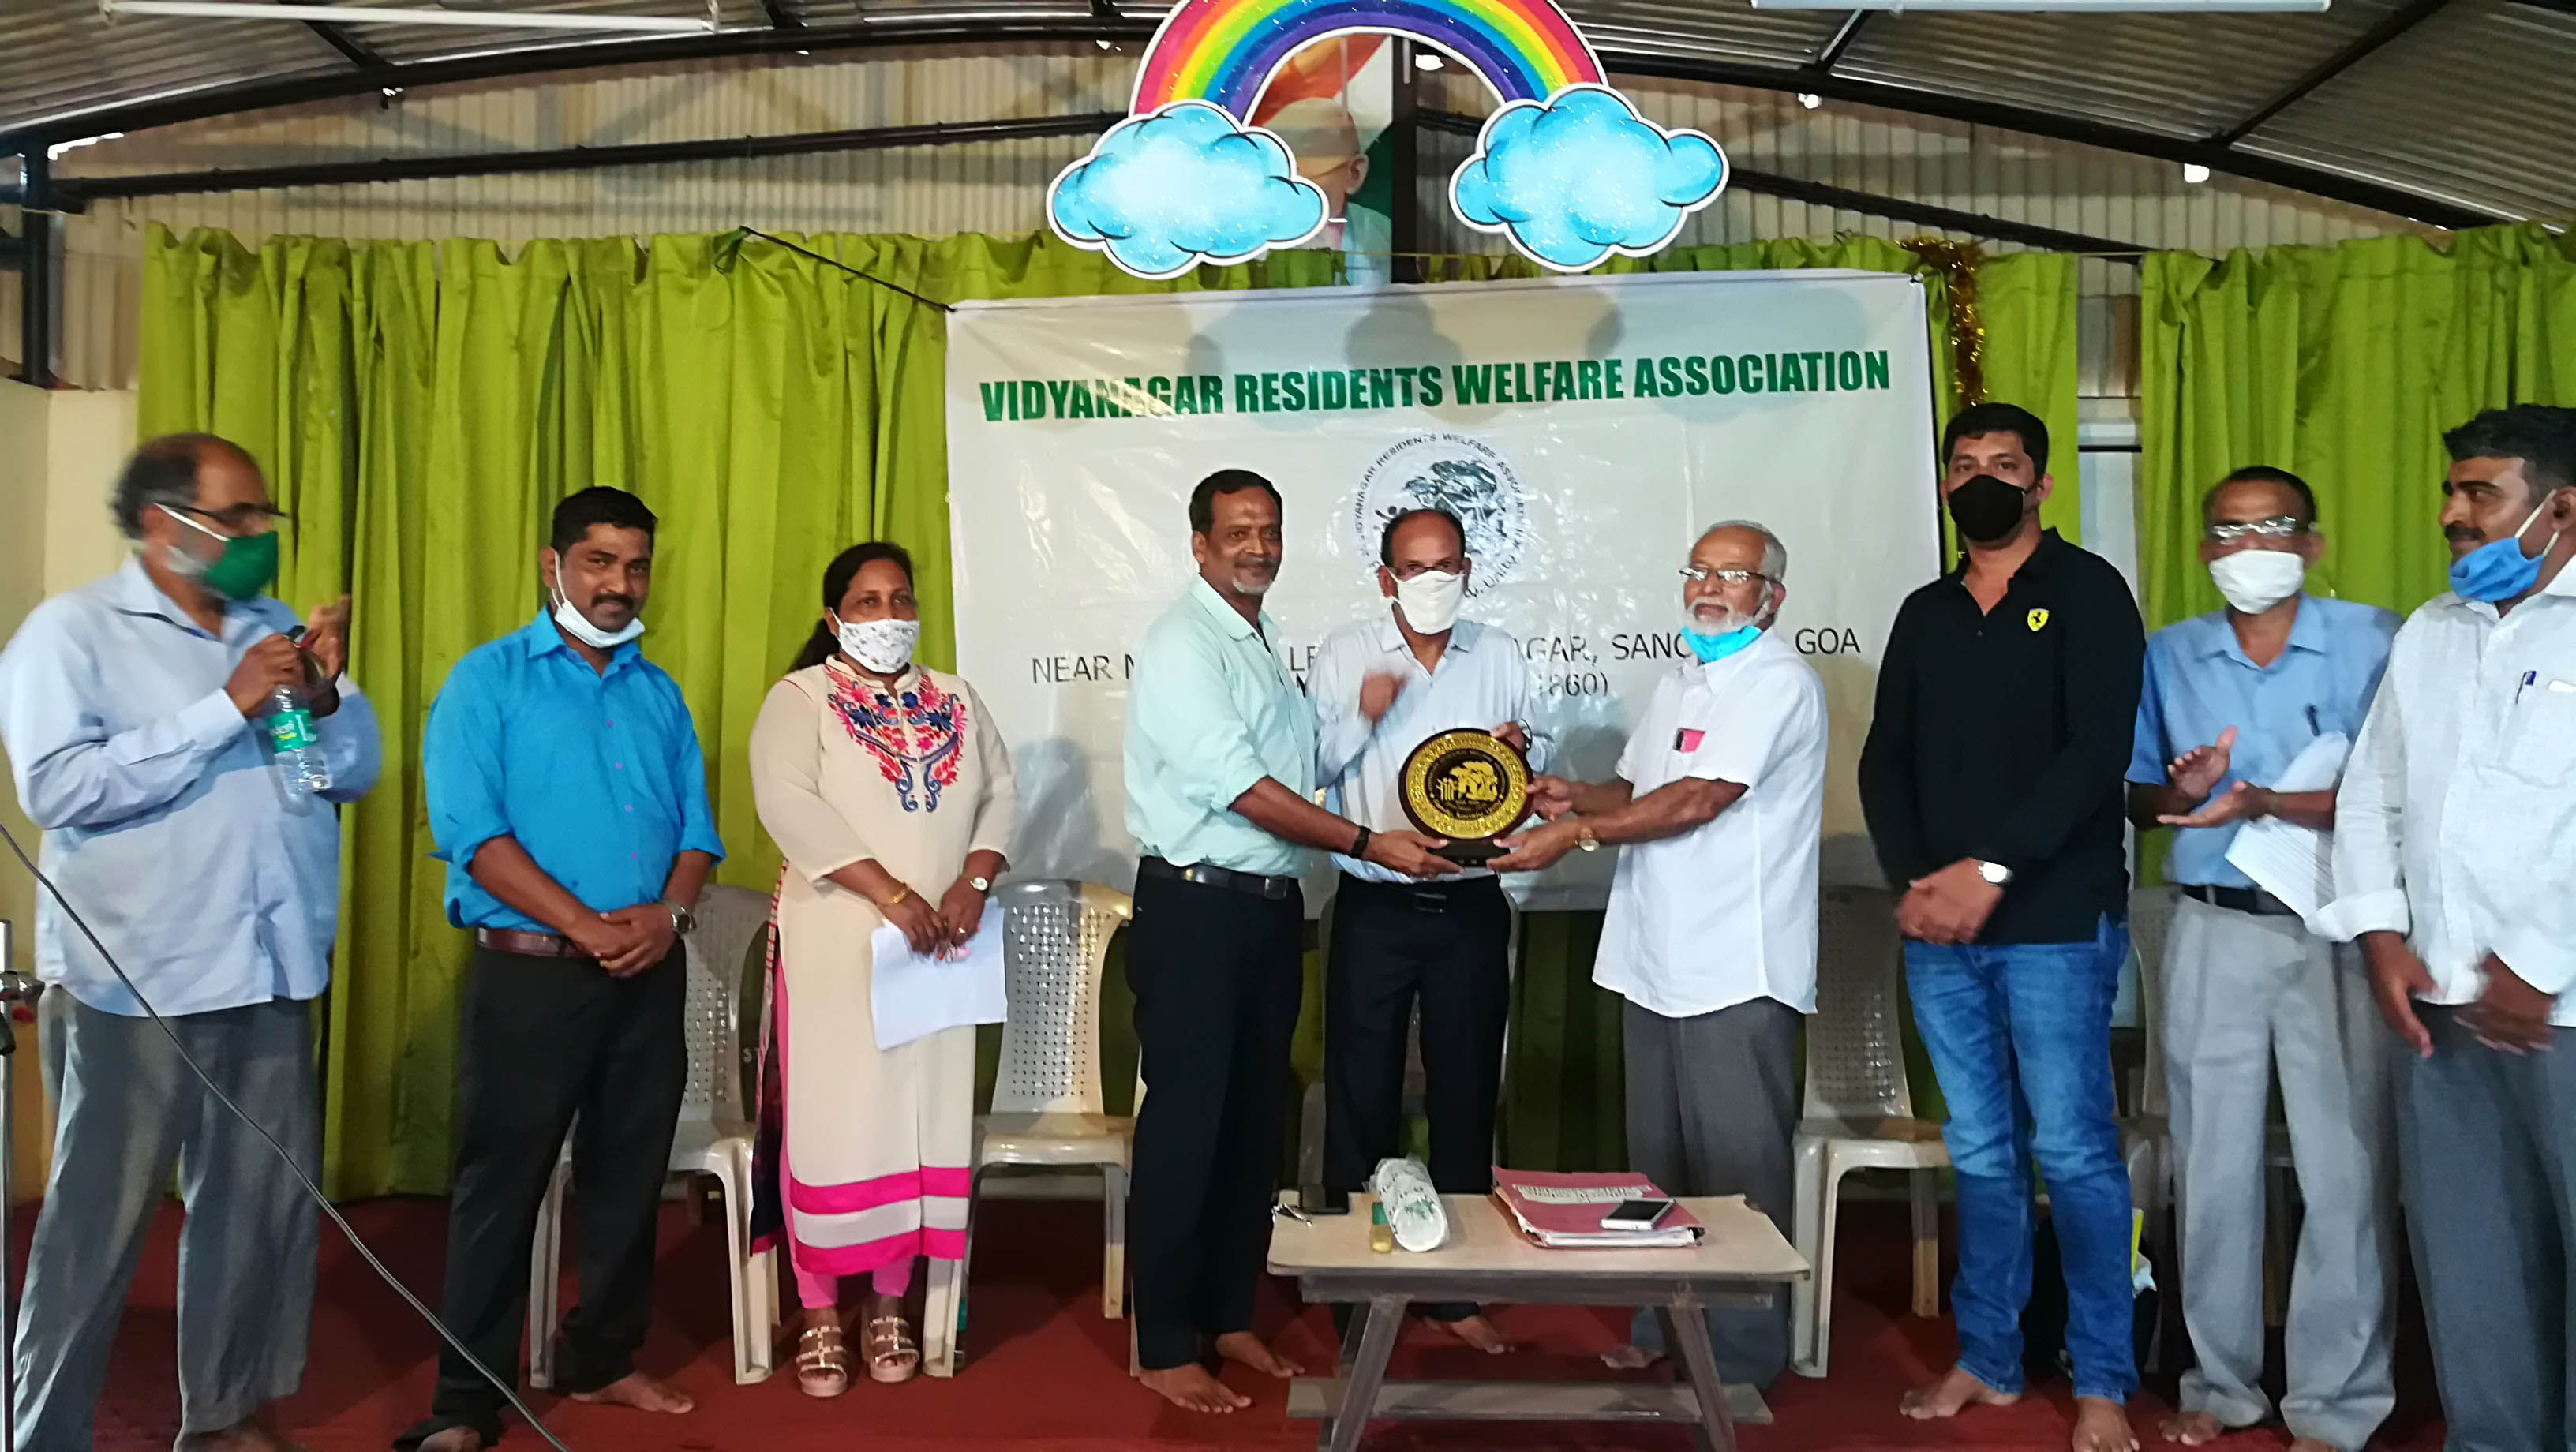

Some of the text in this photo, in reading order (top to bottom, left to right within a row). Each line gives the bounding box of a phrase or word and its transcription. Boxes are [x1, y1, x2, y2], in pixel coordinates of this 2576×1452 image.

[1234, 365, 1443, 413] RESIDENTS
[1452, 359, 1624, 406] WELFARE
[1634, 350, 1890, 398] ASSOCIATION
[1032, 655, 1114, 685] NEAR
[1795, 627, 1862, 655] GOA
